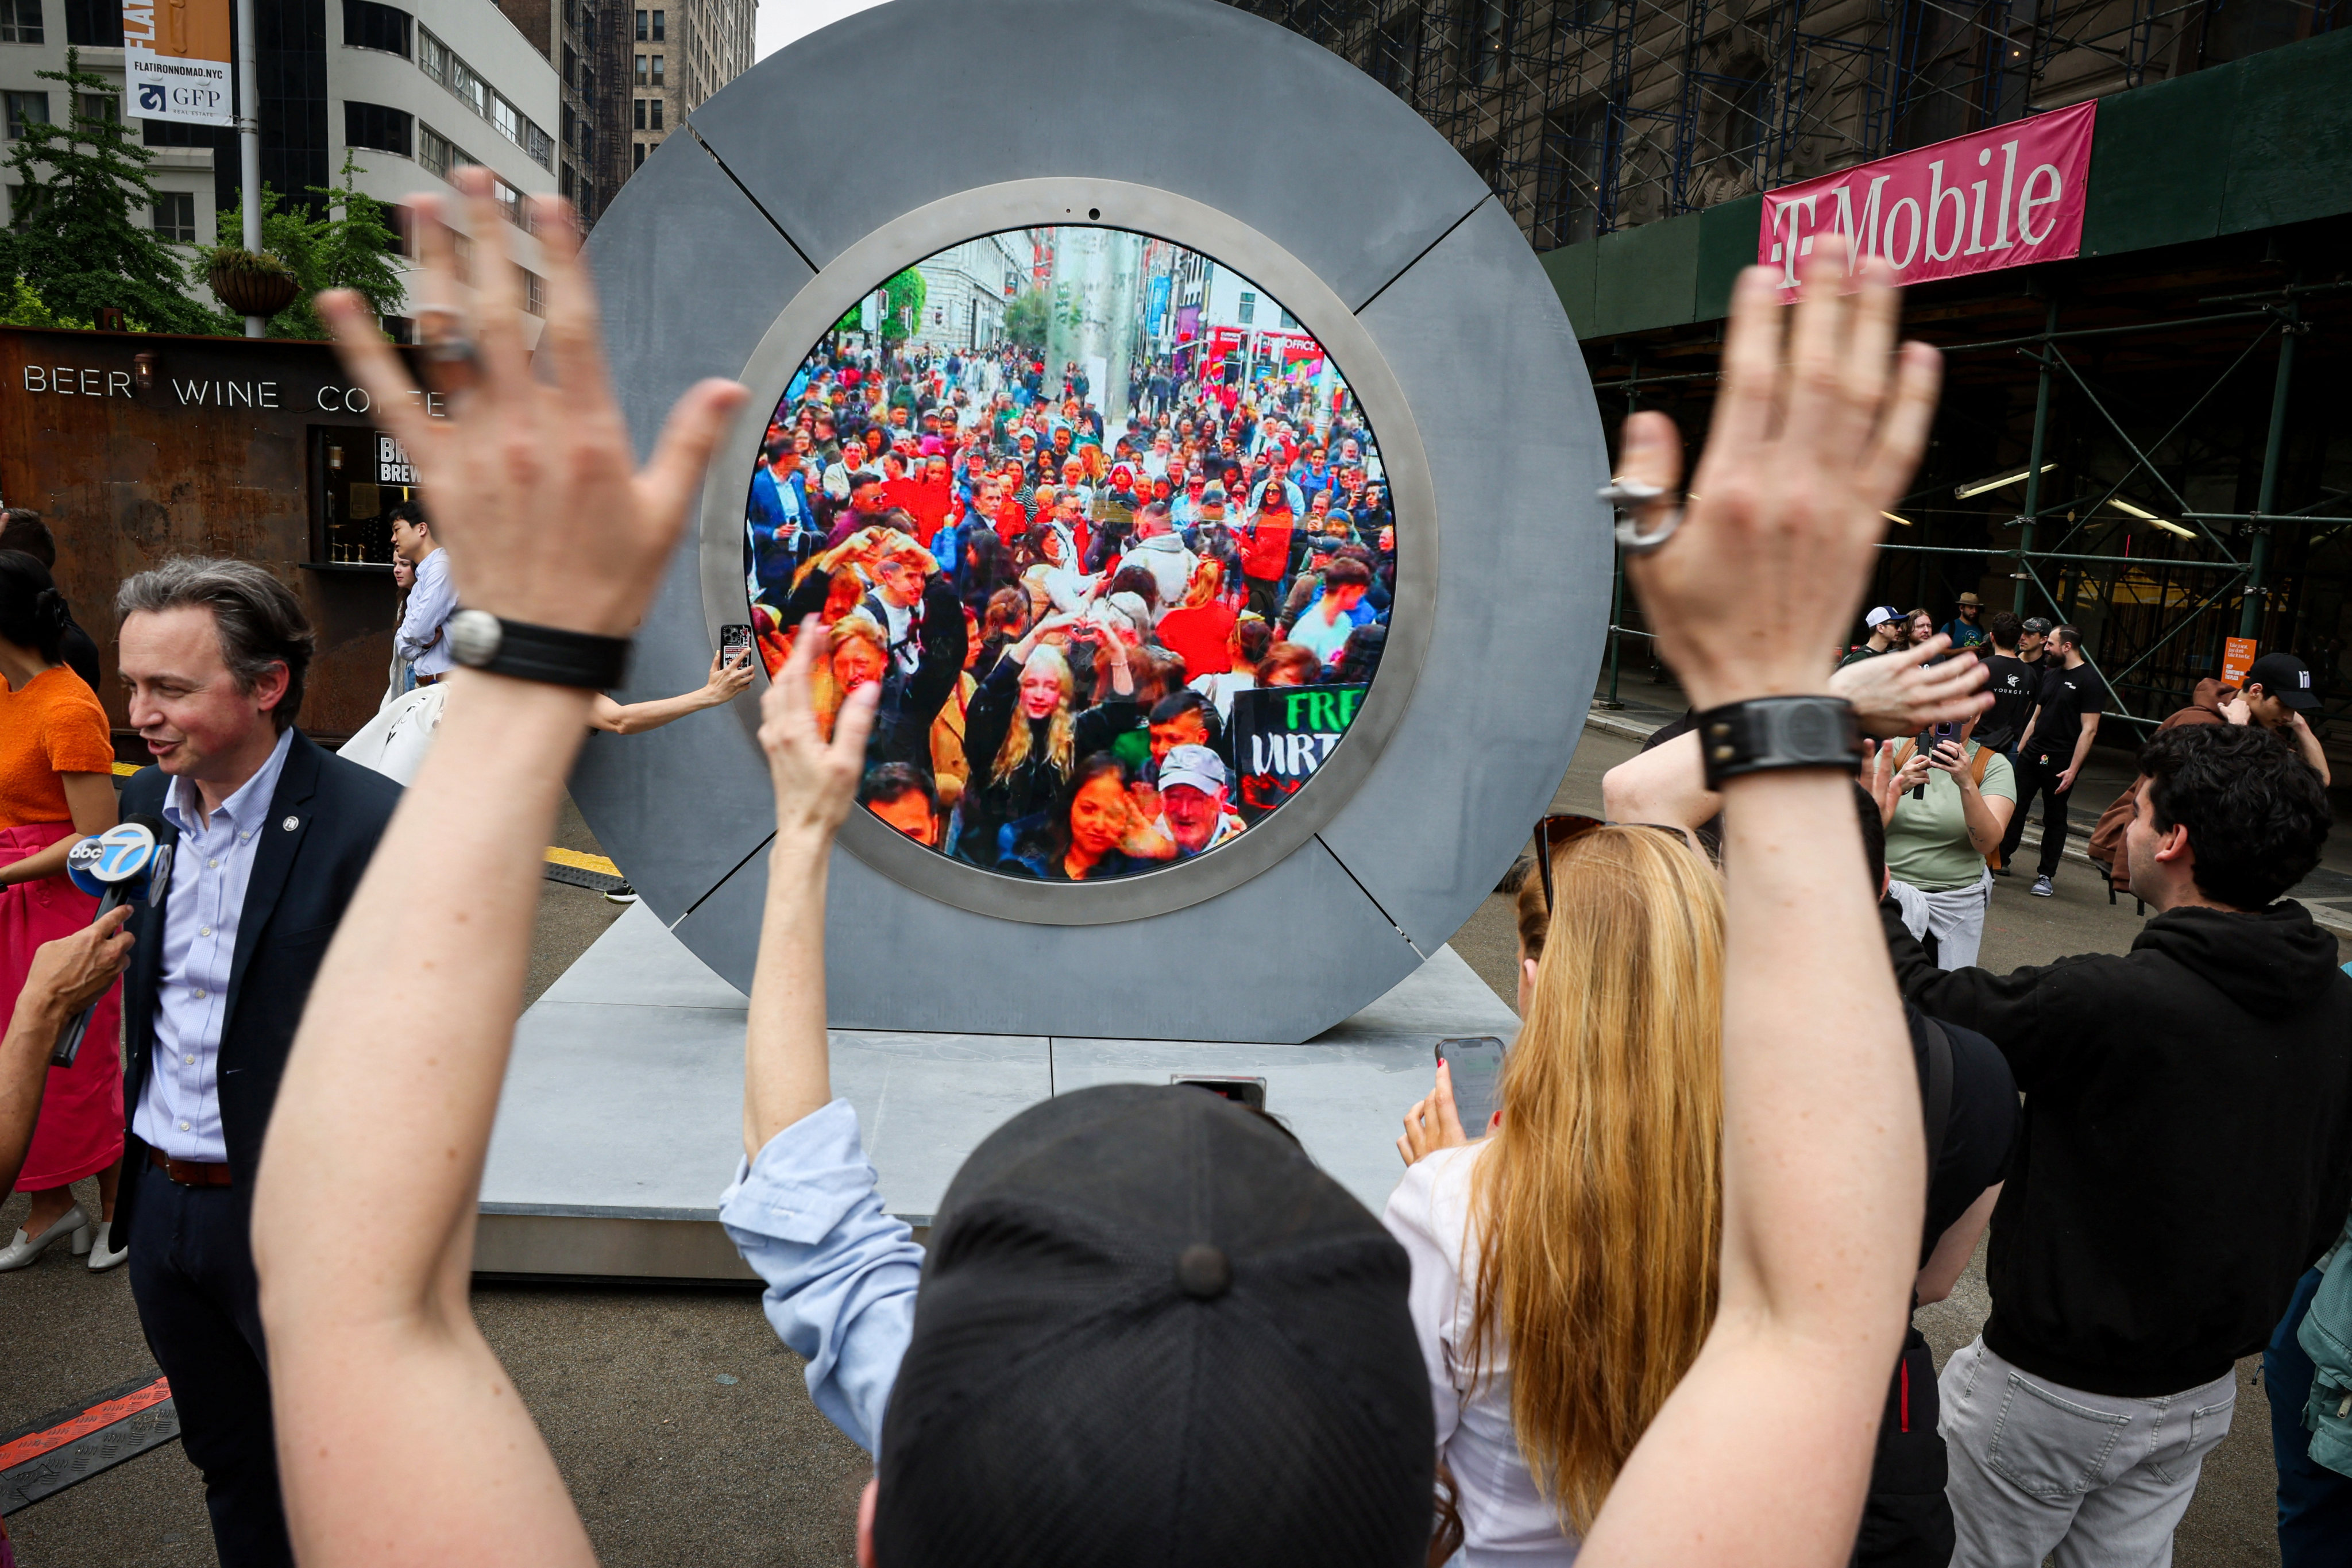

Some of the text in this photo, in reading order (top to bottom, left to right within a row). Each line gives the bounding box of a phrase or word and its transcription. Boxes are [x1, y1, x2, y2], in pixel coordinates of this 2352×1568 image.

[134, 61, 223, 79] FLATIRONNOMAD.NYC
[173, 87, 221, 108] GFP
[1286, 338, 1315, 352] OFFICE
[24, 365, 132, 398] BEER
[172, 379, 279, 408] WINE
[69, 847, 102, 859] abc
